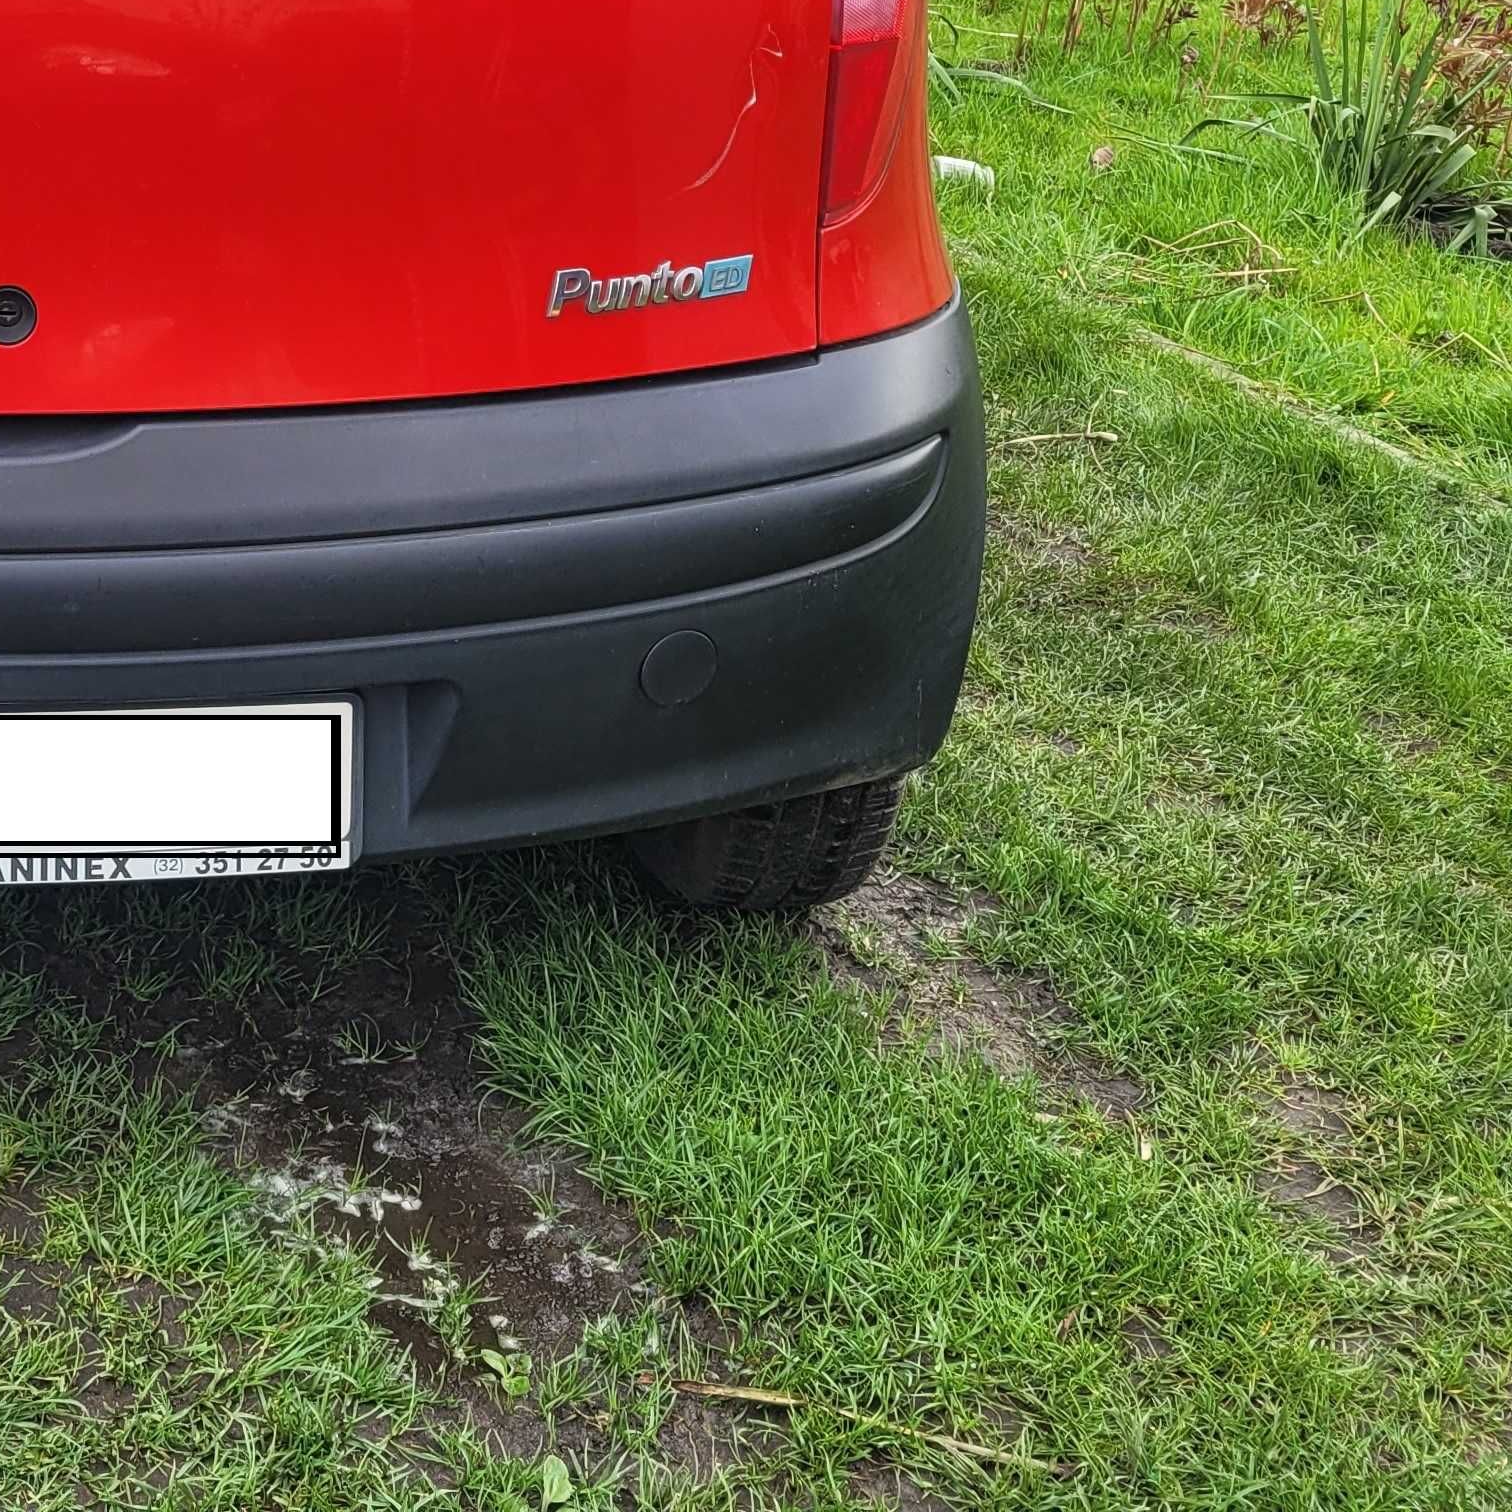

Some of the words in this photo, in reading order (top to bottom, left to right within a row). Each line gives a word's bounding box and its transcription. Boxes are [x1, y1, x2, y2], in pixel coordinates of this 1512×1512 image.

[547, 260, 703, 319] Punto
[153, 858, 184, 875] (32)
[195, 851, 243, 875] 351
[257, 848, 289, 871] 27
[300, 846, 333, 869] 50
